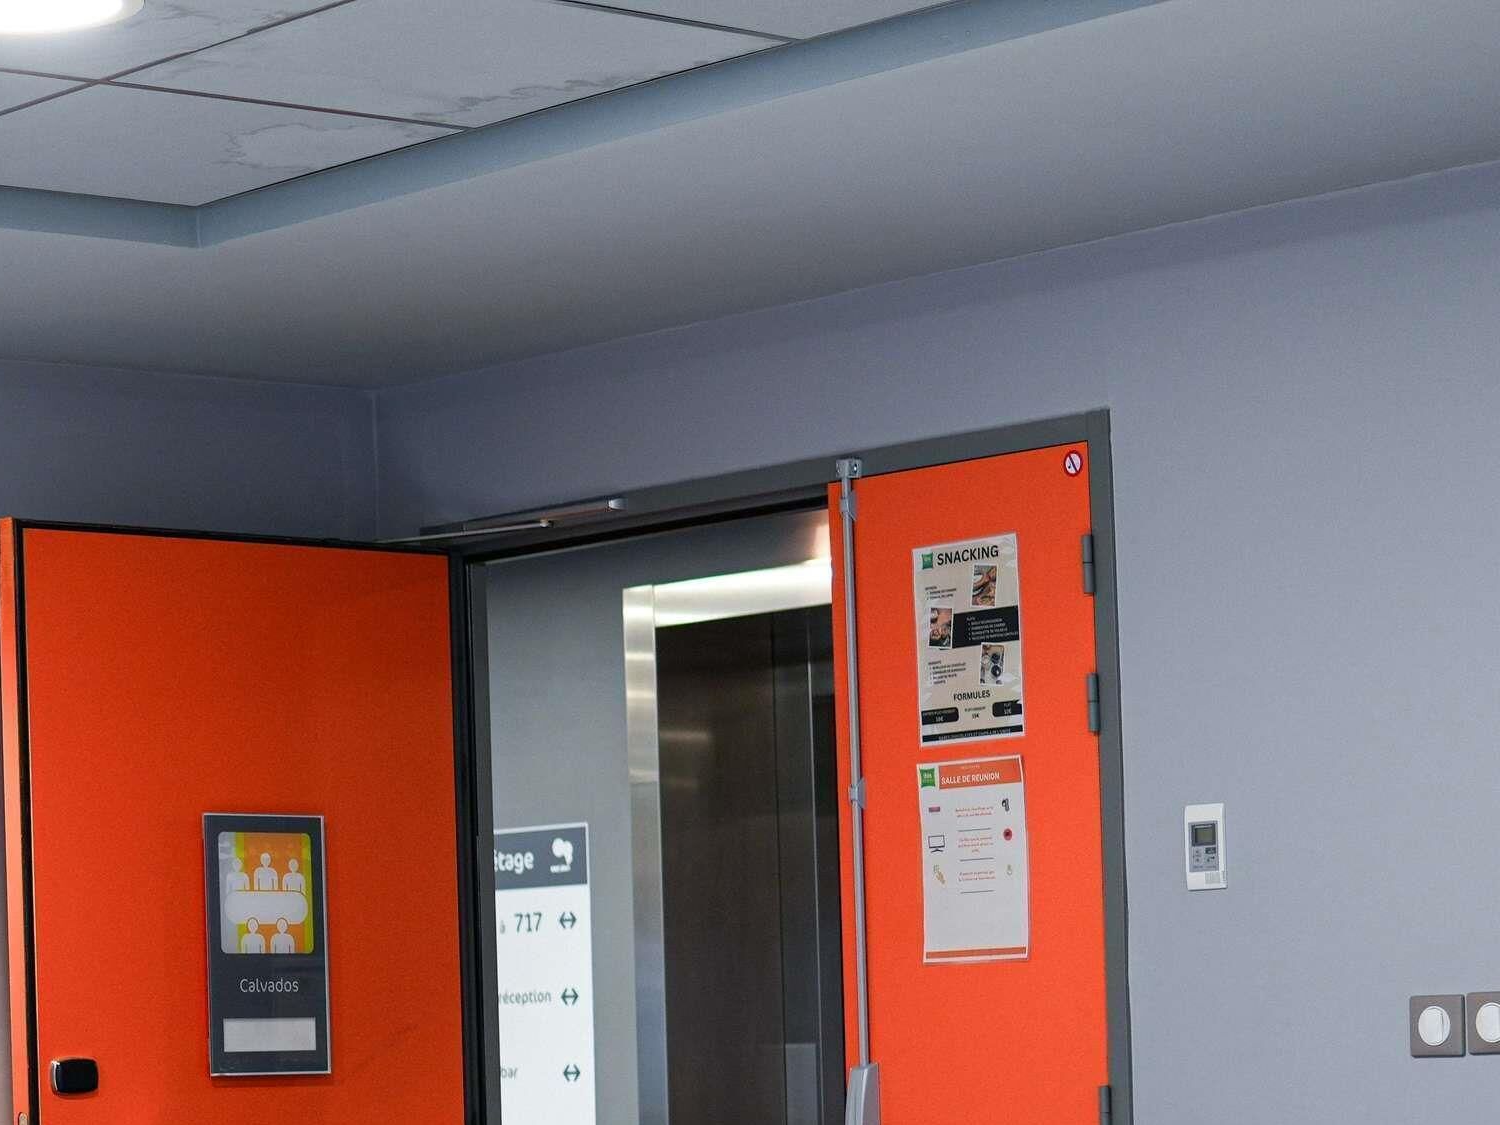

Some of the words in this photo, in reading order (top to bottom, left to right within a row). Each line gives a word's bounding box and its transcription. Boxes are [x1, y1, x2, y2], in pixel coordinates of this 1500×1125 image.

[937, 545, 999, 566] SNACKING
[953, 690, 991, 701] FORMULES
[941, 775, 961, 785] SALLE
[962, 774, 971, 783] DE
[514, 911, 542, 933] 717
[239, 978, 299, 993] Calvados
